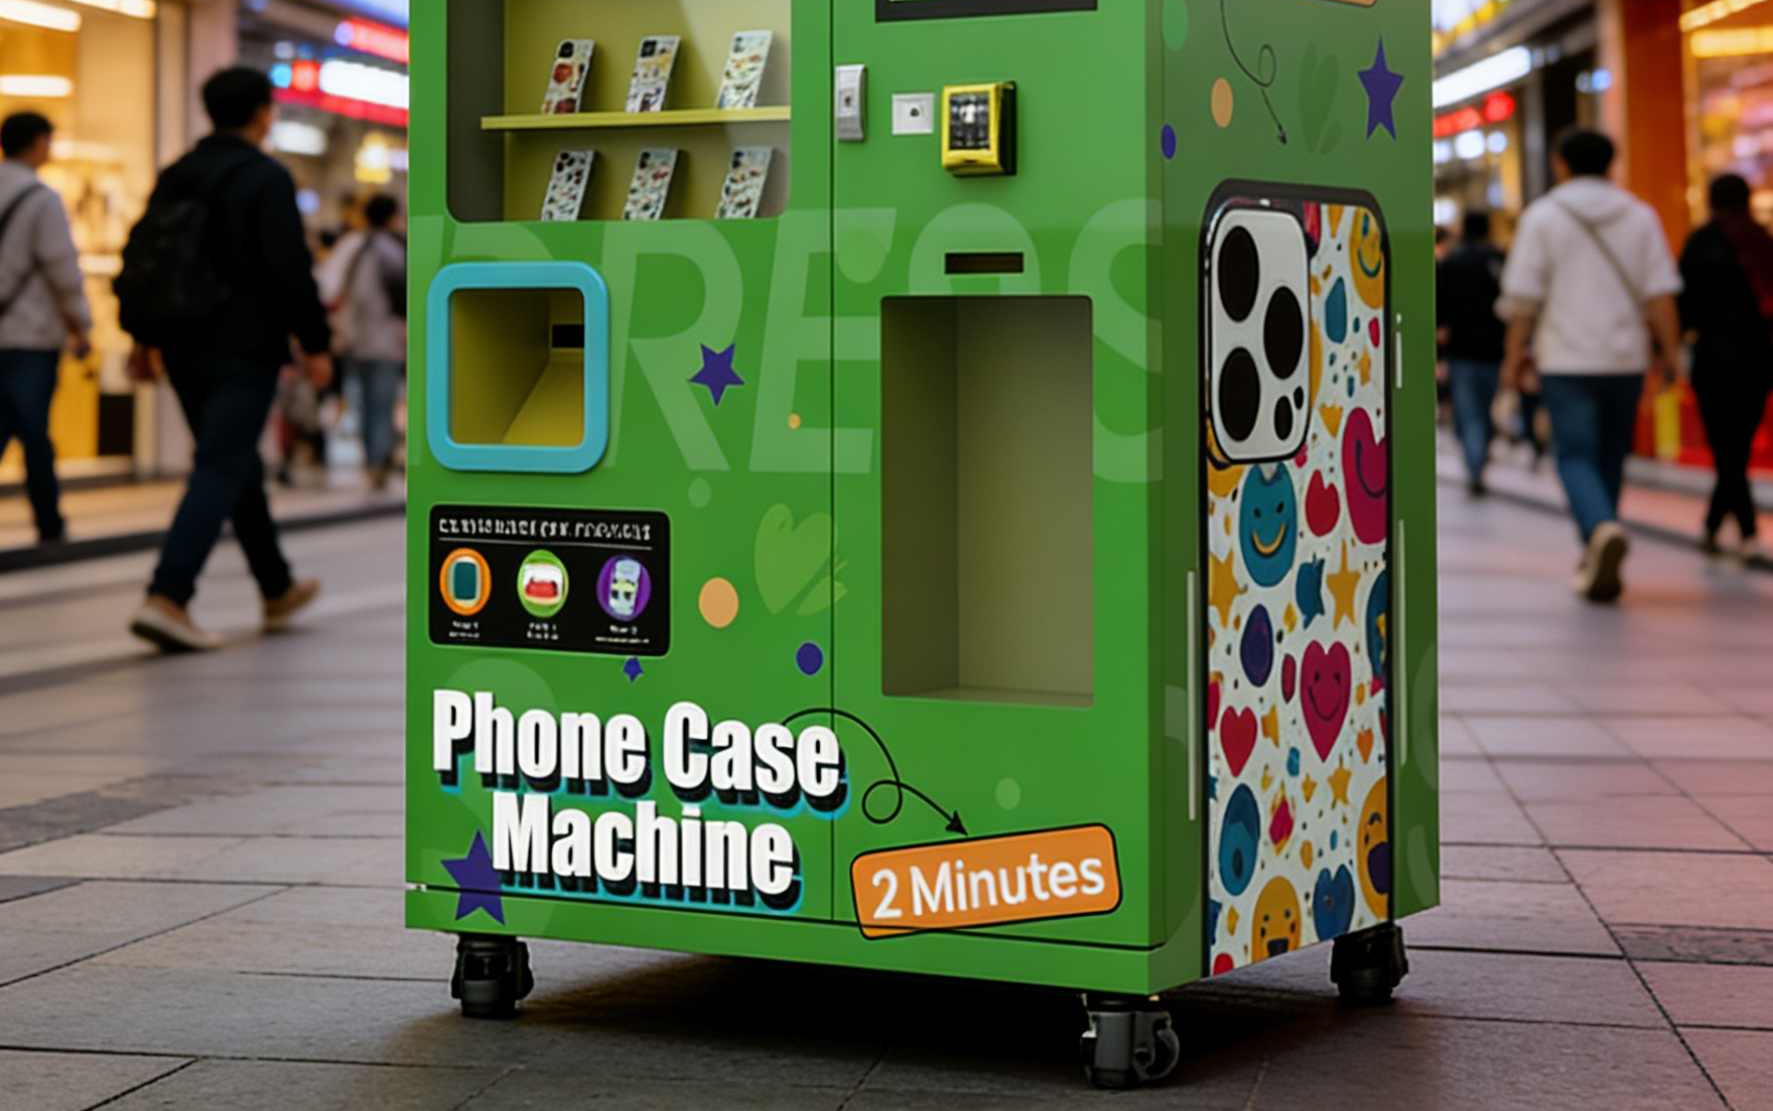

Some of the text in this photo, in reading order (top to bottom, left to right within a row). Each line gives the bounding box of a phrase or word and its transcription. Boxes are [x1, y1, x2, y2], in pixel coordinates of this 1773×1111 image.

[432, 689, 841, 797] Phone Case
[492, 790, 794, 895] Machine
[871, 853, 1105, 919] 2 Minutes
